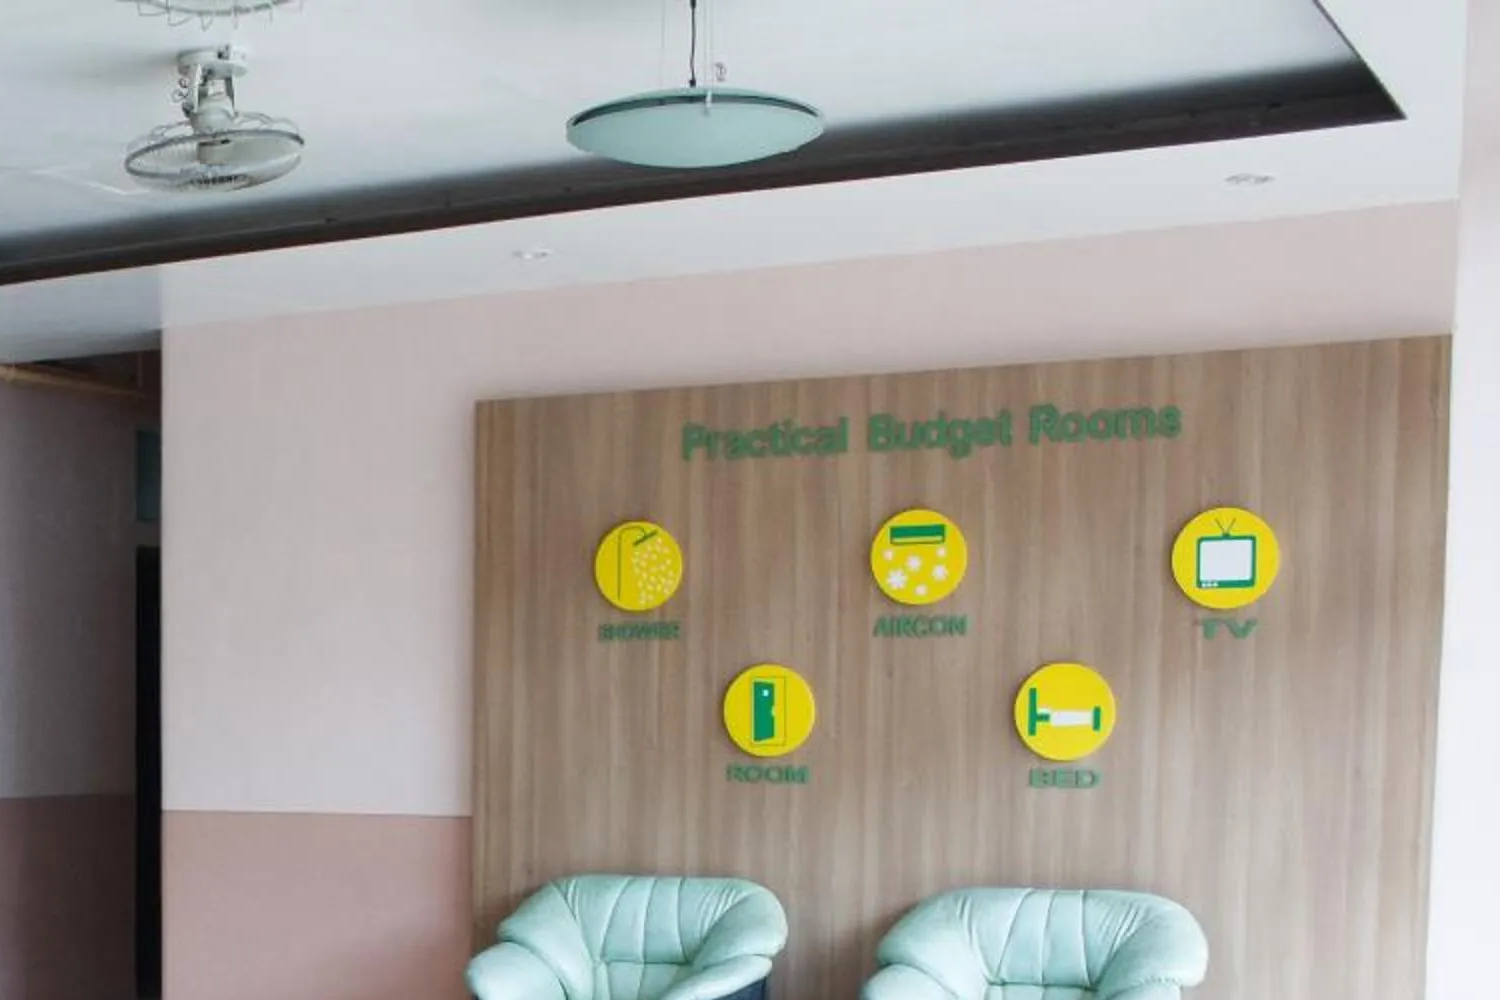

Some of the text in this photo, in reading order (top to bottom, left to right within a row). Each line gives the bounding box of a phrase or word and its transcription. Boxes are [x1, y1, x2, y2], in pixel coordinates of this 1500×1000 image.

[681, 403, 1183, 462] Practical Budget Rooms
[872, 613, 968, 638] AIRCON
[1196, 617, 1258, 640] TV
[725, 762, 810, 785] ROOM
[1028, 766, 1102, 789] BED
